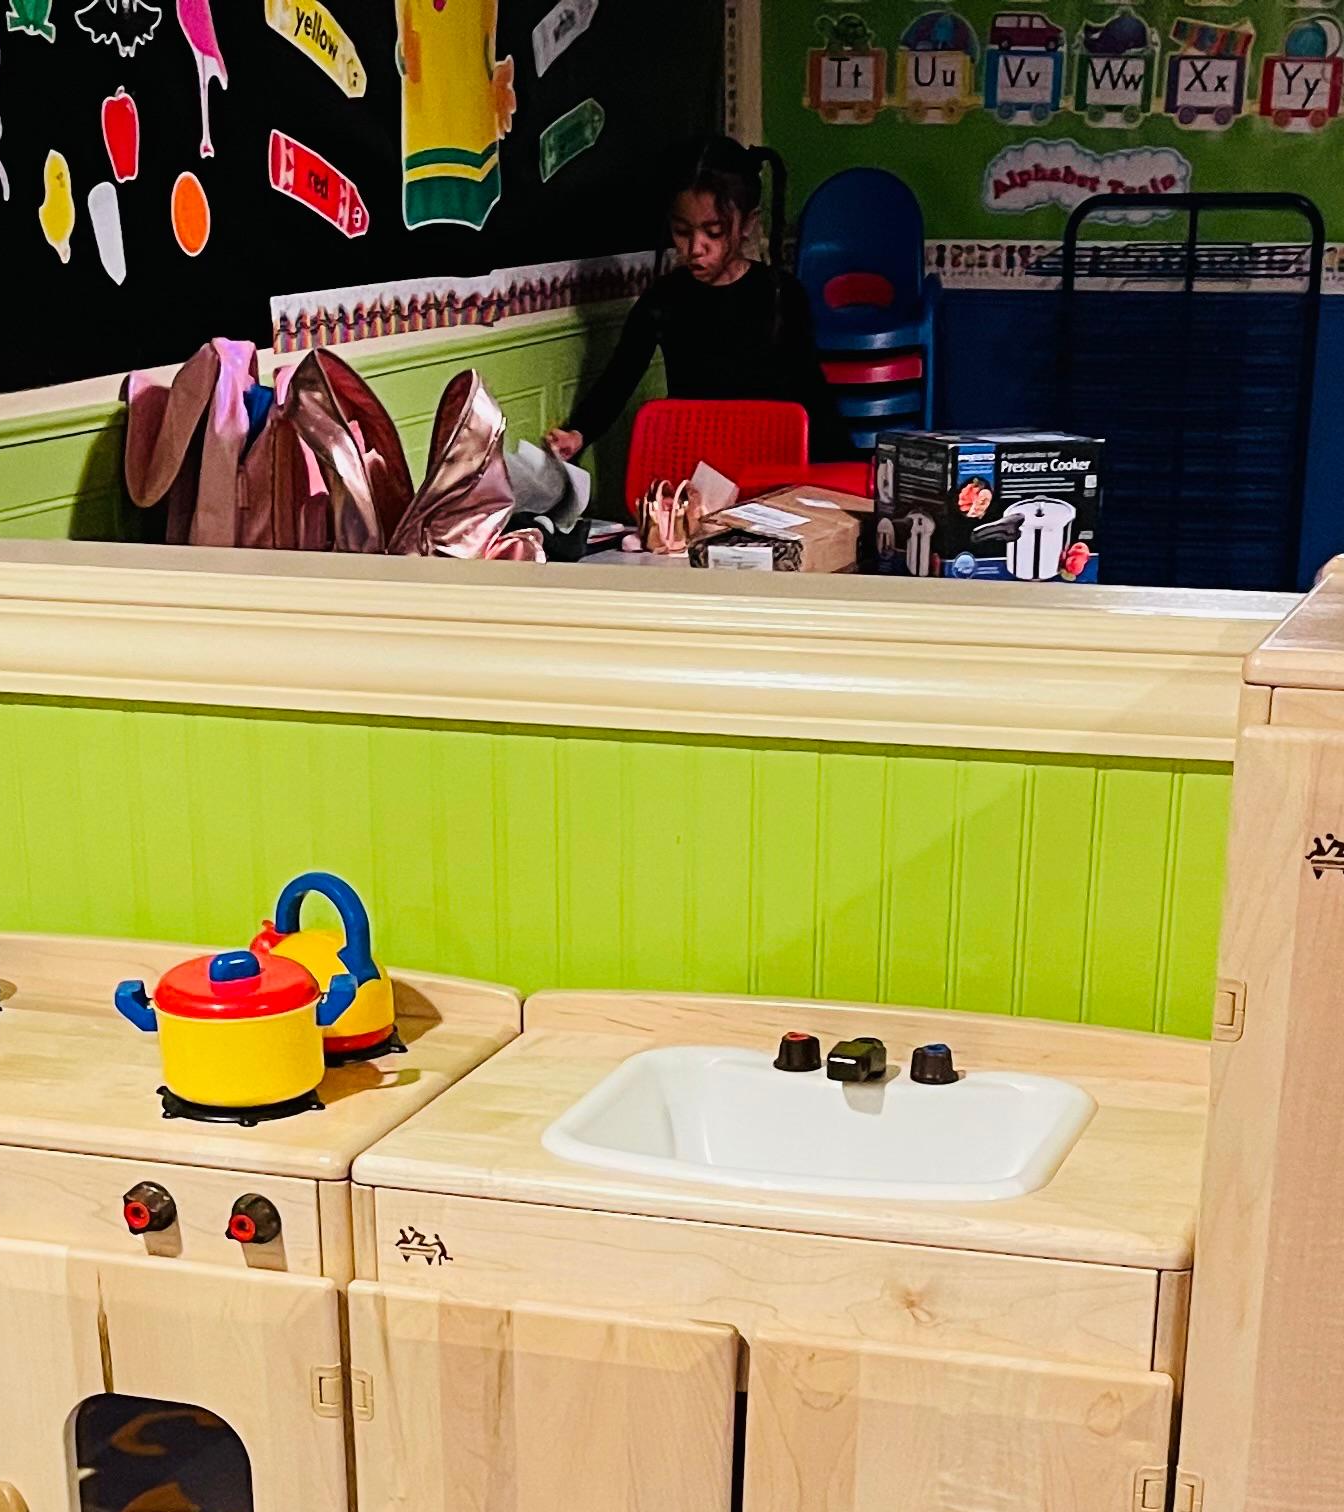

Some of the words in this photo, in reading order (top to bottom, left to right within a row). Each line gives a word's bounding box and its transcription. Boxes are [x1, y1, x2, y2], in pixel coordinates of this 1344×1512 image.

[294, 7, 338, 61] yellow
[829, 57, 862, 88] Tt
[914, 56, 955, 87] Uu
[1004, 57, 1040, 88] Vv
[1089, 60, 1145, 90] Ww
[1184, 61, 1227, 92] Xx
[1280, 63, 1321, 108] Yy
[307, 169, 329, 201] red
[994, 163, 1100, 199] Alphabet
[1000, 459, 1048, 473] Pressure
[1050, 457, 1091, 472] Cooker
